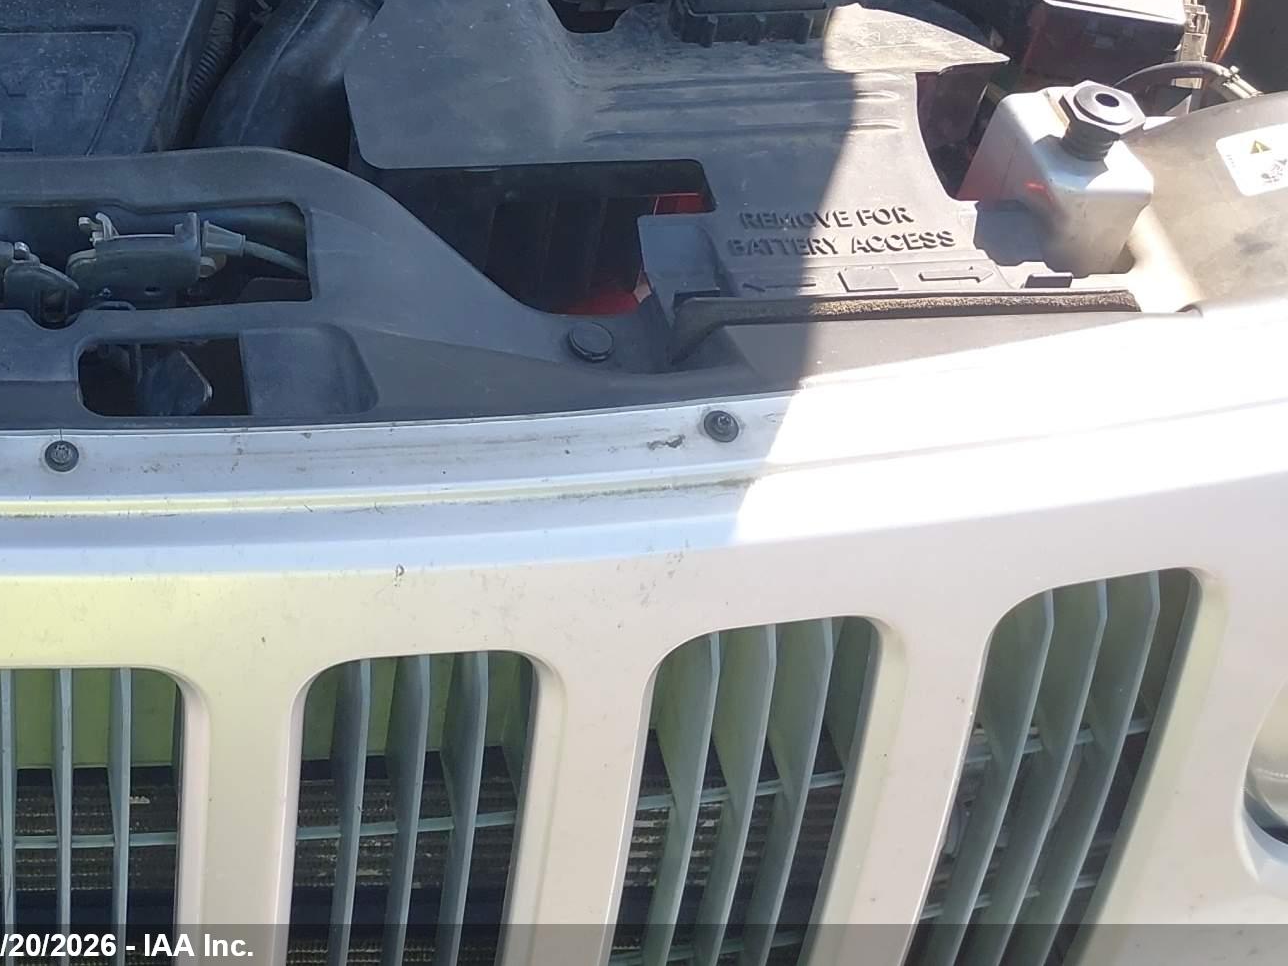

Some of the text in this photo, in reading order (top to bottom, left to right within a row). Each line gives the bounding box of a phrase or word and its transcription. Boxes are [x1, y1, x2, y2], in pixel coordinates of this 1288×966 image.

[739, 206, 914, 229] REMOVE FOR
[728, 230, 956, 256] BATTERY ACCESS
